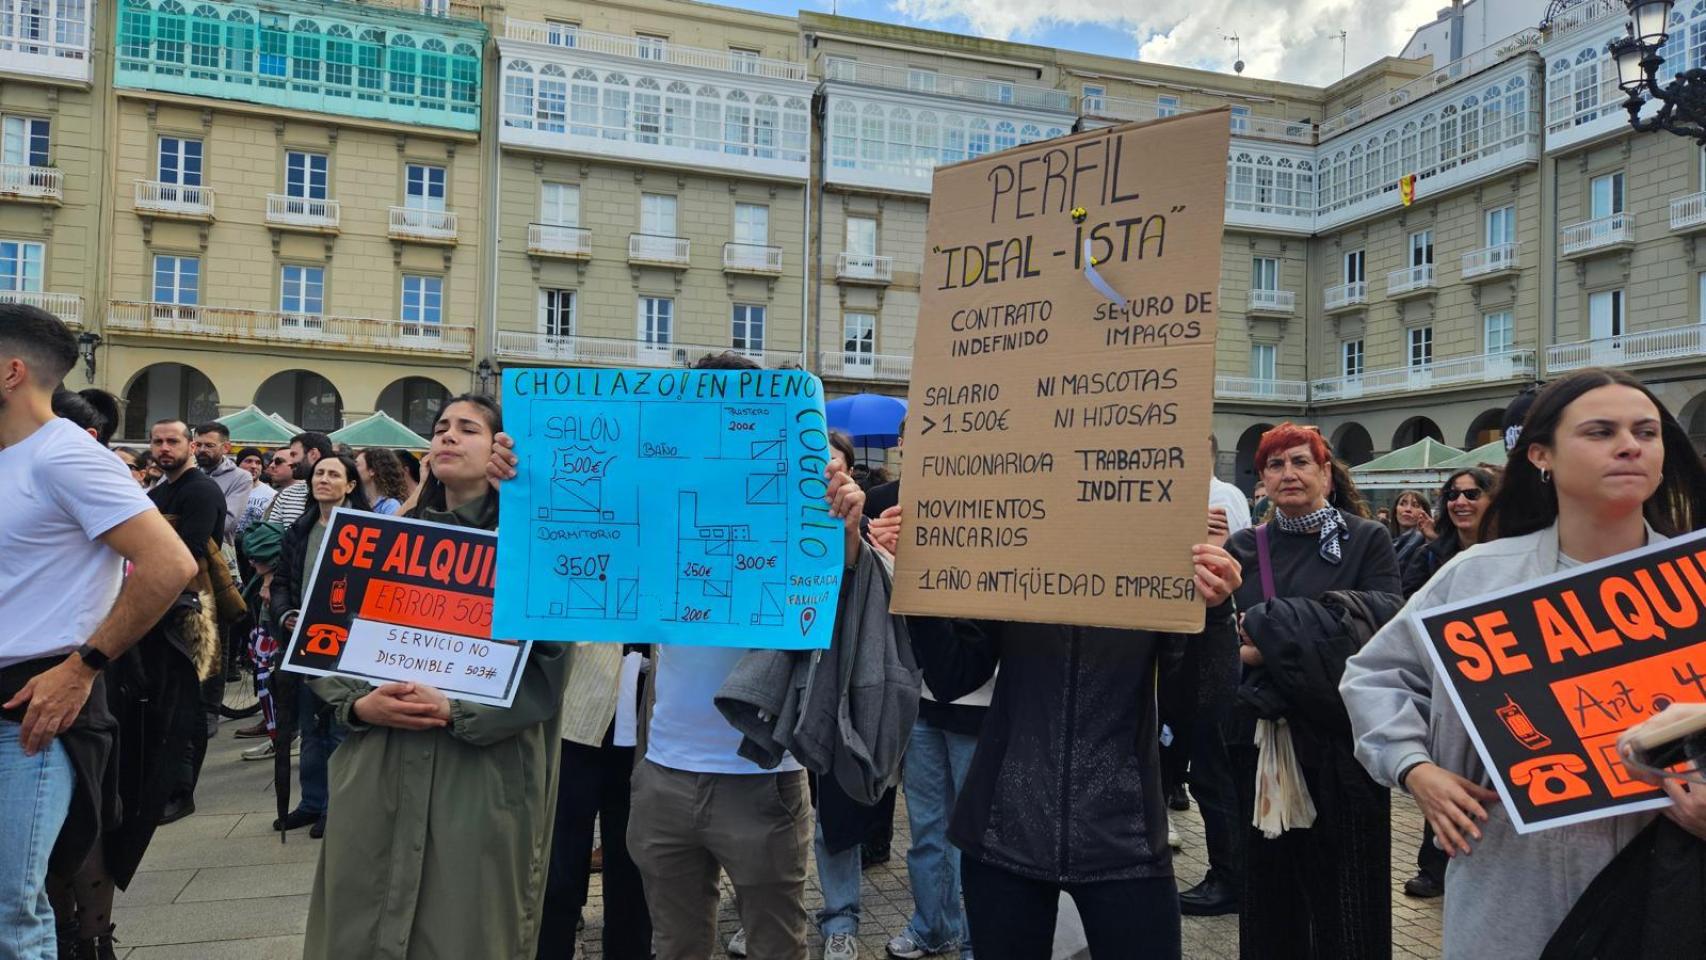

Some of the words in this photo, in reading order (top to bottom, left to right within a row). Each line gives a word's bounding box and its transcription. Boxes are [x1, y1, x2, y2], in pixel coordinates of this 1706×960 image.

[988, 135, 1139, 223] PERFIL
[951, 300, 1052, 332] CONTRATO
[1093, 295, 1174, 322] SEGURO
[1185, 291, 1213, 314] DE
[952, 328, 1048, 358] INDEFINIDO
[1106, 320, 1201, 346] IMPAGOS
[515, 371, 690, 401] CHOLLAZO!
[696, 373, 728, 399] EN
[739, 372, 817, 400] PLENO
[923, 383, 999, 406] SALARIO
[1037, 376, 1055, 398] NI
[1061, 368, 1178, 395] MASCOTAS
[728, 420, 756, 432] 200€
[942, 409, 1011, 434] 1.500€
[1054, 408, 1074, 428] NI
[1083, 402, 1178, 428] HIJOS/AS
[560, 453, 603, 474] 500€
[922, 451, 1054, 477] FUNCIONARIO/A
[1075, 446, 1184, 471] TRABAJAR
[795, 408, 838, 559] COGOLLO
[917, 498, 1046, 520] MOVIMIENTOS
[538, 529, 621, 542] DORMITORIO
[916, 526, 1028, 548] BANCARIOS
[332, 524, 382, 569] SE
[381, 532, 498, 588] ALQUI
[735, 554, 778, 571] 300€
[683, 562, 712, 578] 250€
[789, 575, 838, 587] SAGRADA
[1115, 575, 1196, 602] EMPRESA
[375, 585, 447, 620] ERROR
[452, 598, 494, 628] 503
[681, 606, 711, 622] 200€
[467, 643, 490, 658] NO
[1443, 610, 1534, 683] SE
[464, 664, 498, 679] 503#
